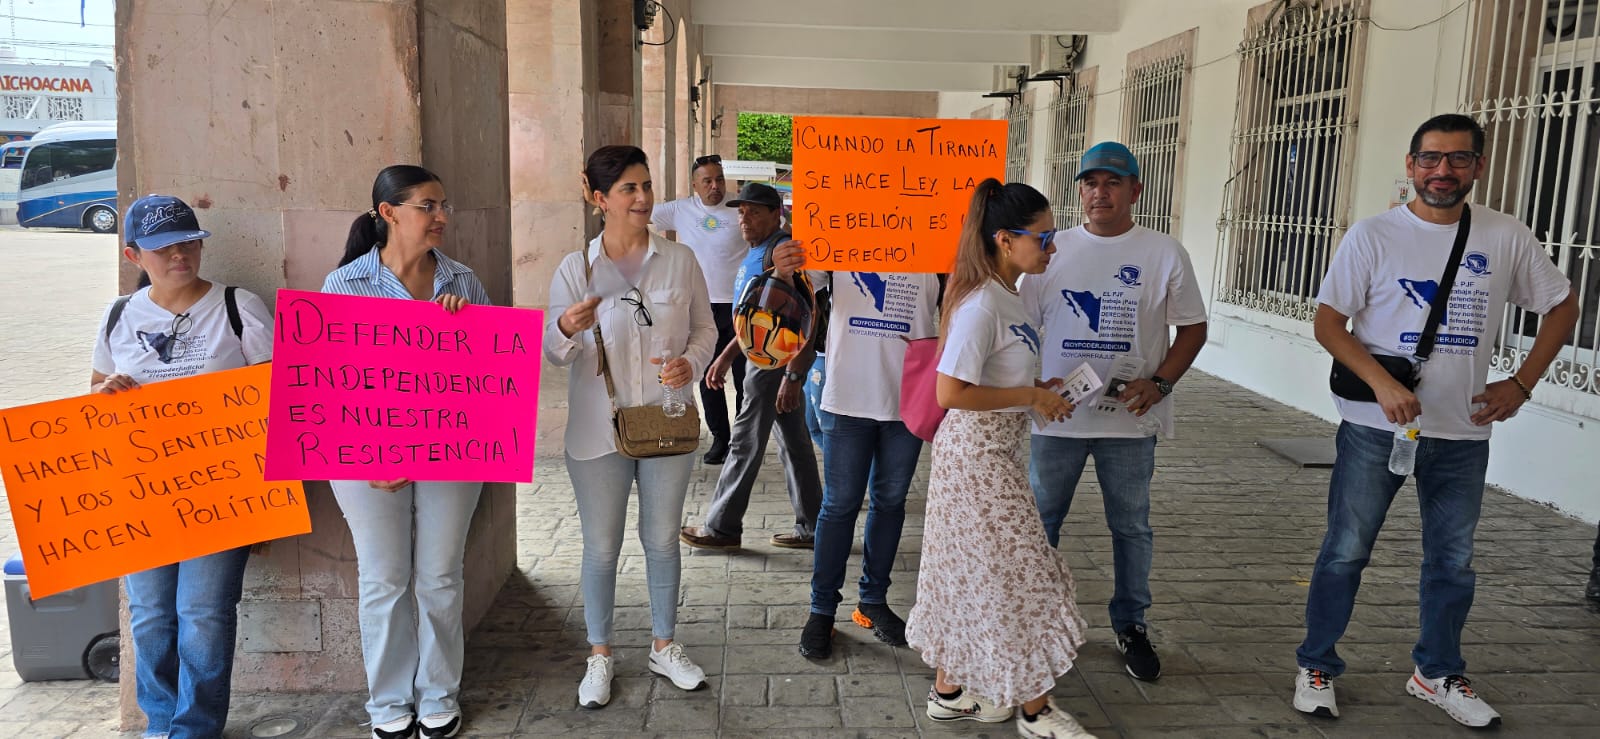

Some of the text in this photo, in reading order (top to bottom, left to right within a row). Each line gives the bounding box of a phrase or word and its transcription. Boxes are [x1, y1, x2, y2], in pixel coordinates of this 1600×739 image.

[897, 138, 915, 153] LA
[917, 126, 997, 158] TIRANÍA
[804, 171, 831, 190] SE
[844, 173, 890, 190] HACE
[953, 177, 976, 191] LA
[805, 203, 913, 231] REBELIÓN
[929, 213, 948, 230] ES
[810, 238, 915, 265] DERECHO!
[493, 332, 527, 355] LA
[1064, 341, 1128, 351] #SOYPODERJUDICIAL
[288, 364, 520, 397] INDEPENDENCIA
[3, 384, 261, 443] LOS POLÍTICOS NO
[288, 403, 469, 430] ES NUESTRA
[14, 447, 113, 483] HACEN
[296, 428, 519, 471] RESISTENCIA!
[25, 499, 43, 523] Y
[60, 489, 113, 517] LOS
[122, 459, 241, 501] JUECES
[37, 486, 299, 566] HACEN POLÍTICA
